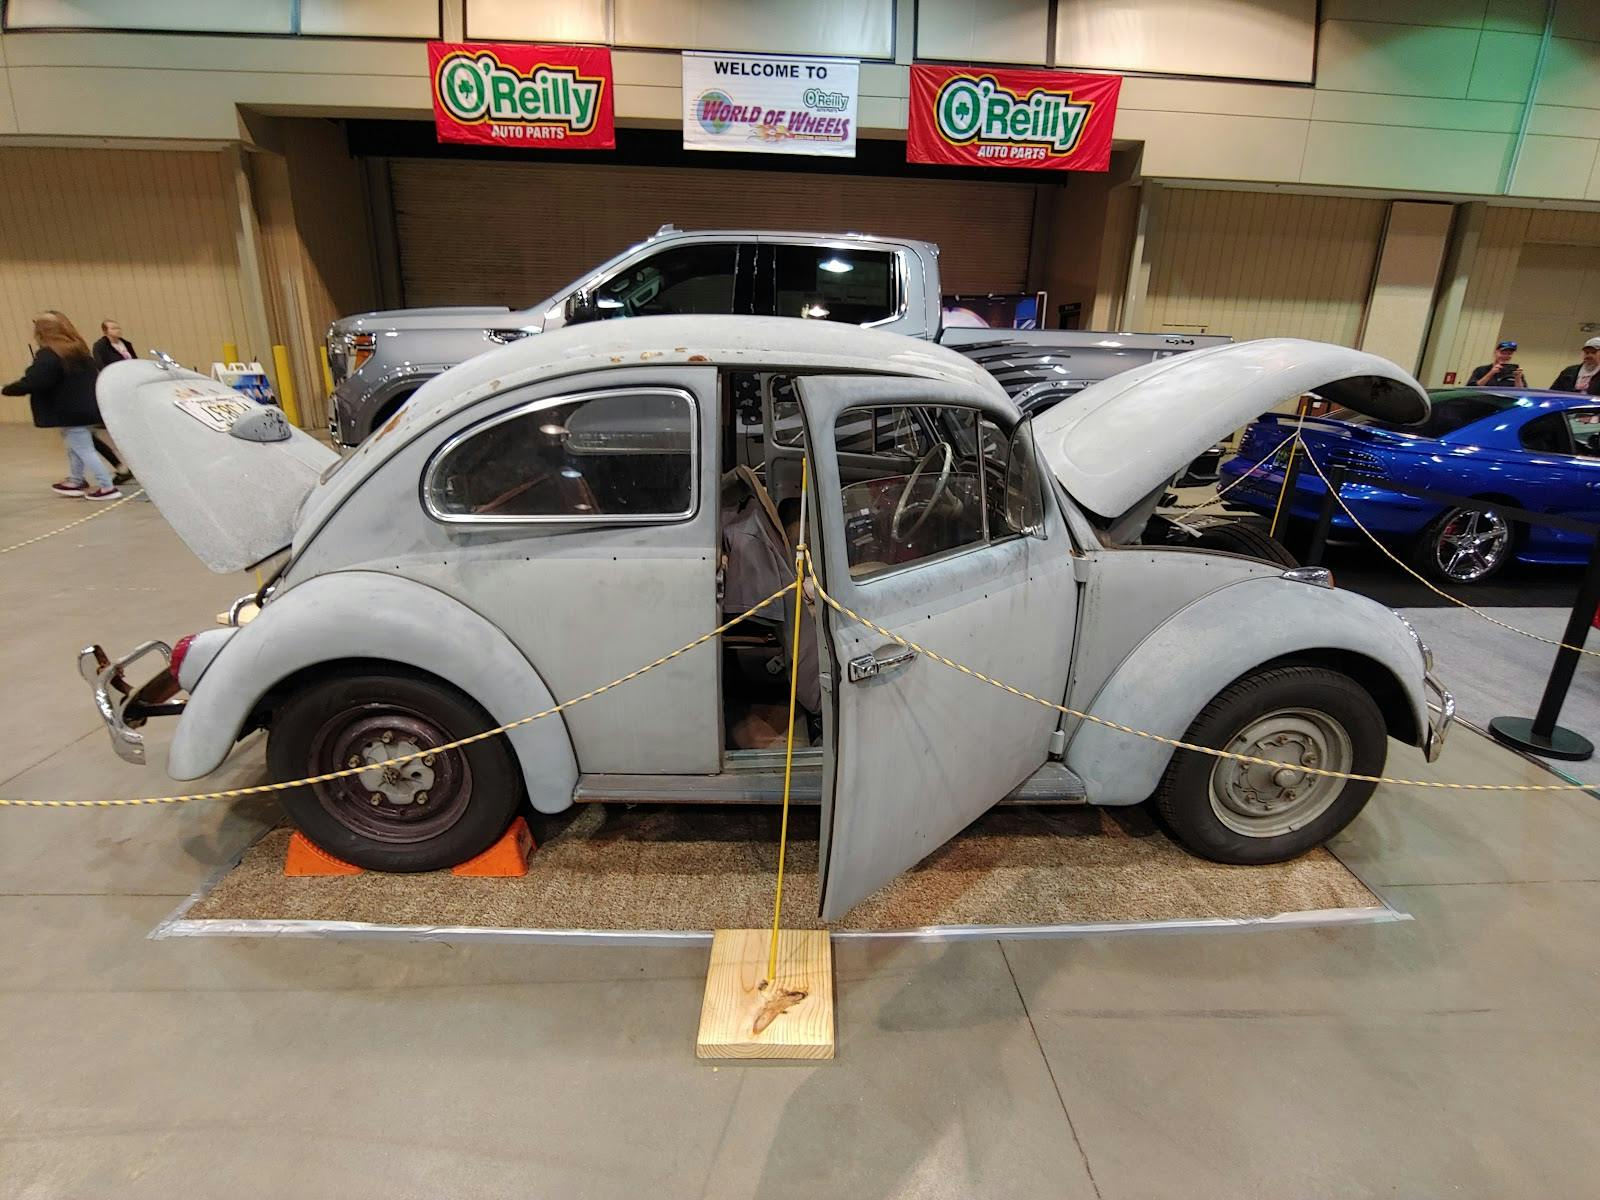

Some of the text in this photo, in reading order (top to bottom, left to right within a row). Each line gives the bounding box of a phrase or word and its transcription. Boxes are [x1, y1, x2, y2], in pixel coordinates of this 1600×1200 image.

[714, 61, 828, 80] WELCOME TO
[445, 61, 593, 125] O'Reilly
[805, 89, 848, 110] O'Reilly
[701, 100, 850, 142] WORLD OF WHEELS
[944, 84, 1082, 147] O'Reilly
[491, 124, 565, 140] AUTO PARTS
[977, 145, 1047, 160] AUTO PARTS
